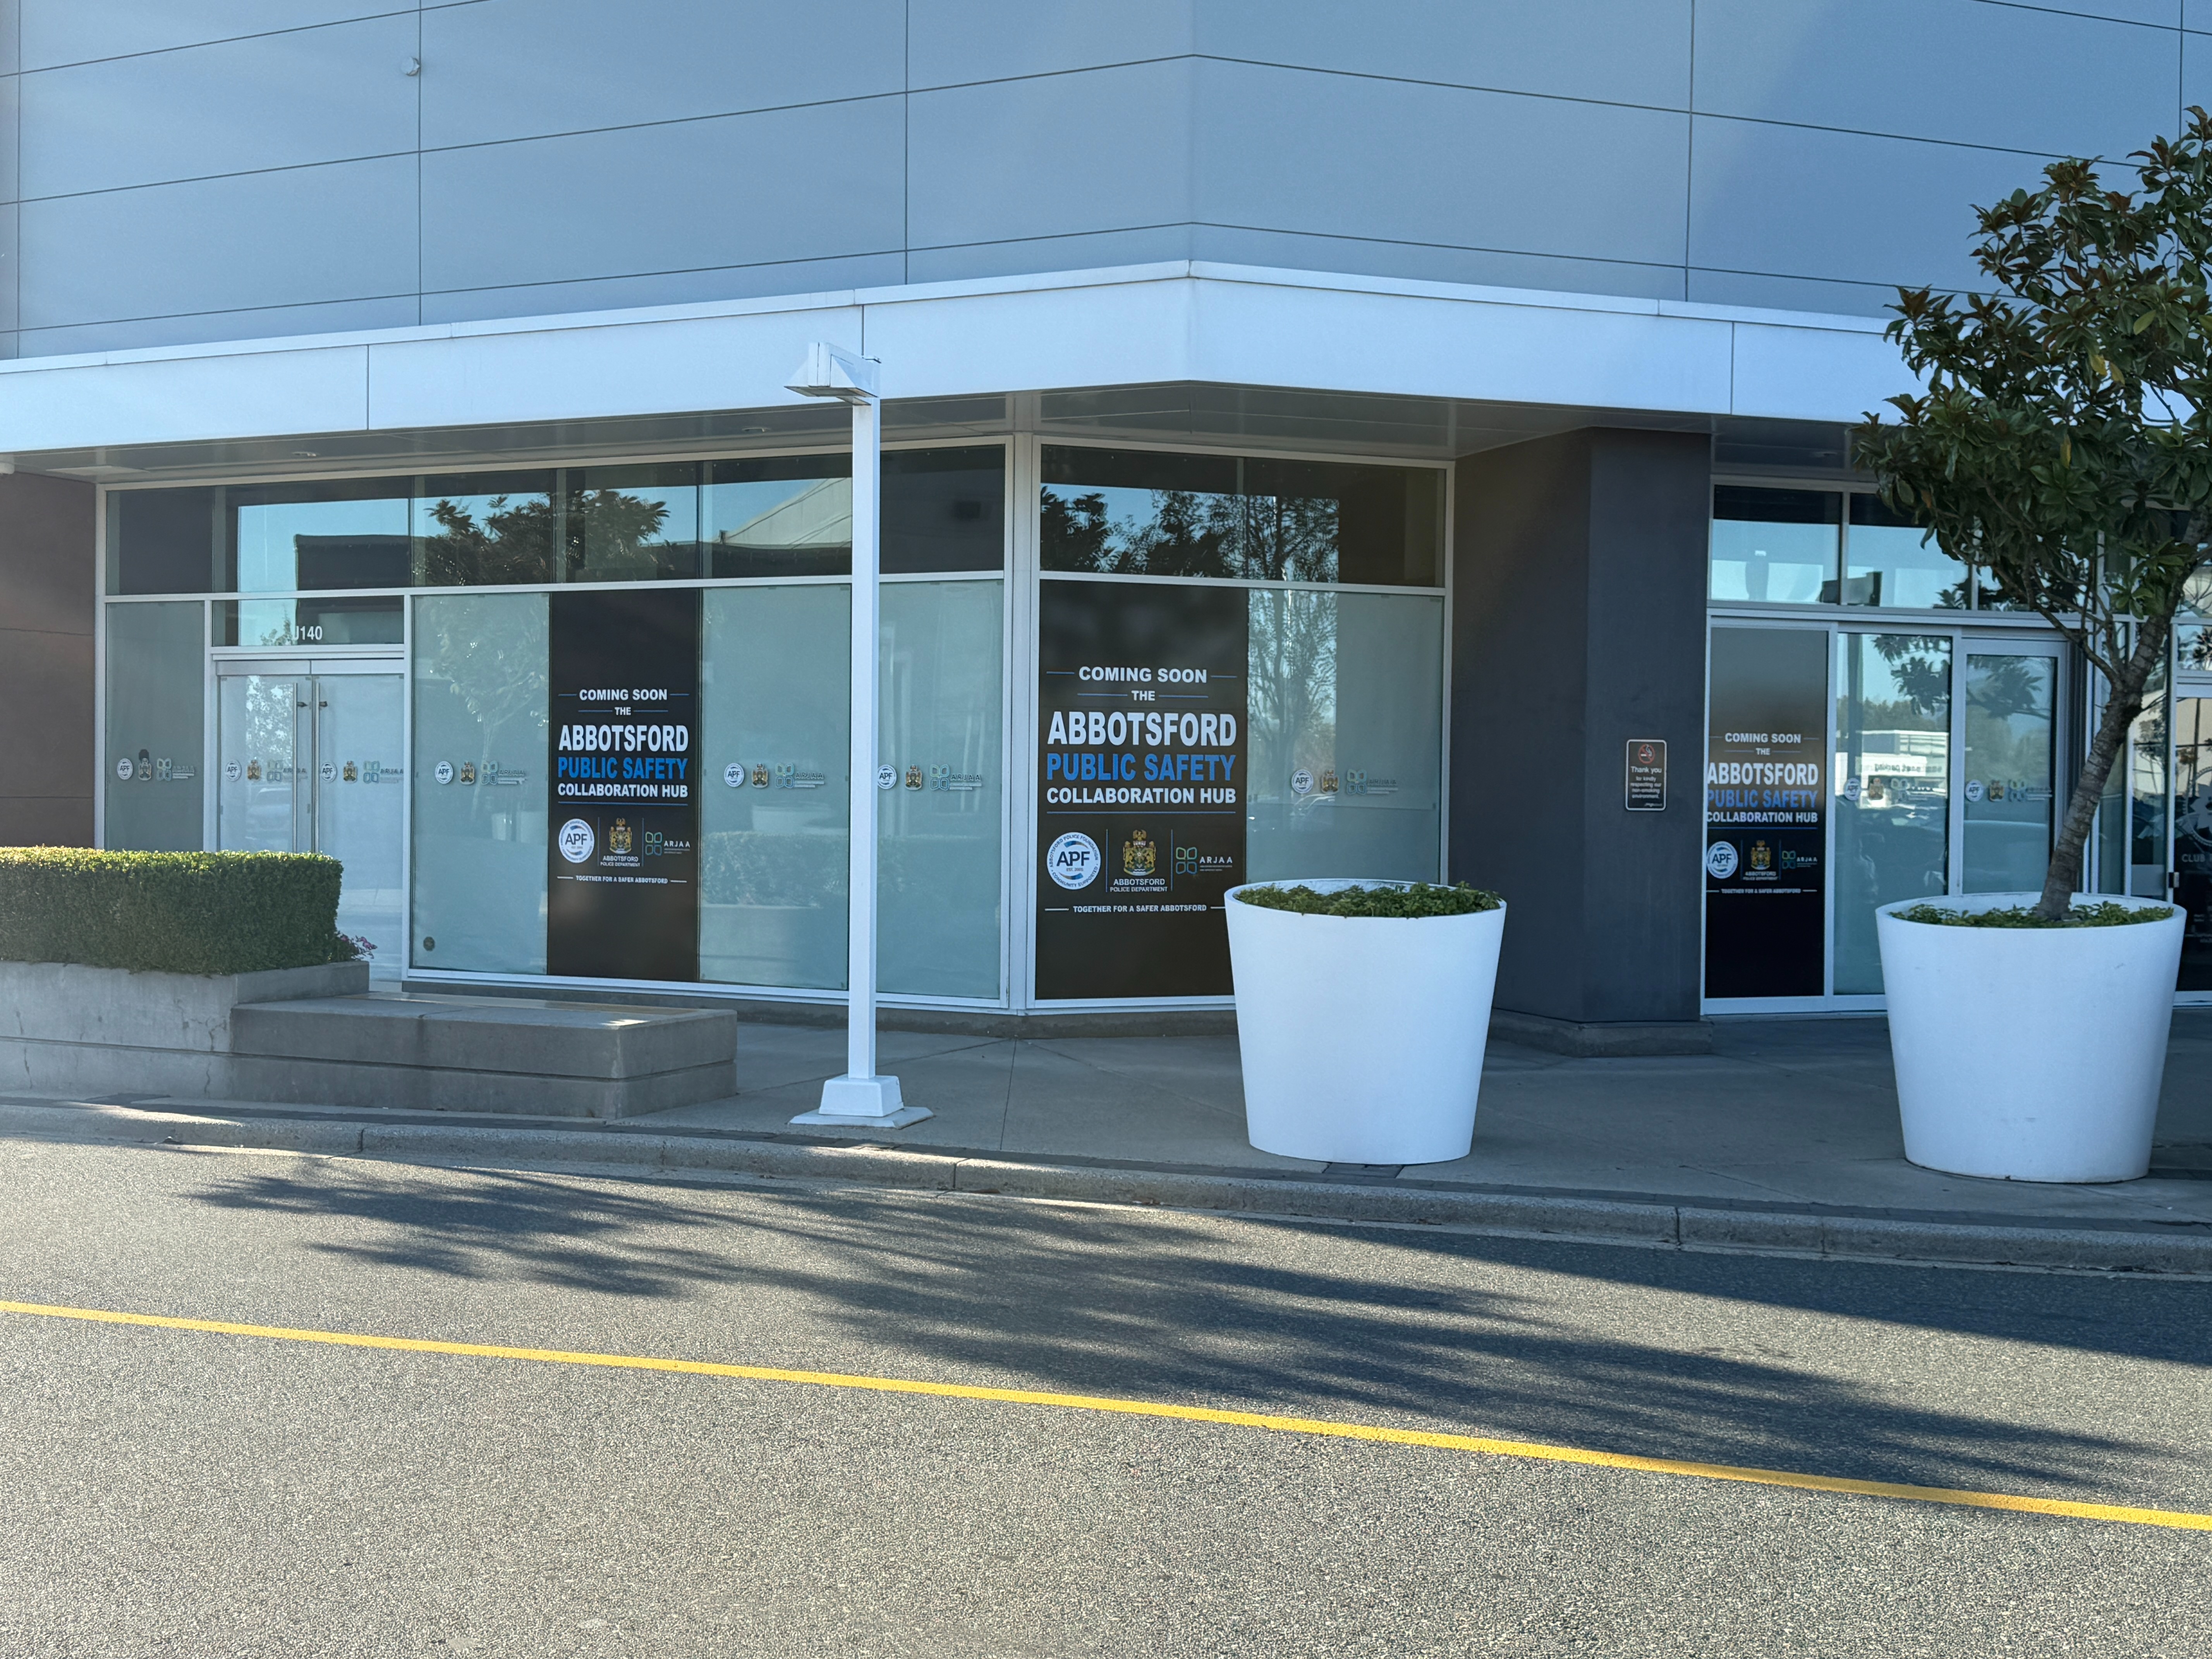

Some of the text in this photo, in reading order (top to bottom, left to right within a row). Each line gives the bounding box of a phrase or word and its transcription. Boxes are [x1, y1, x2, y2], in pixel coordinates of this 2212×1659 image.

[1079, 666, 1207, 683] COMING SOON
[579, 689, 667, 701] COMING SOON
[1131, 690, 1155, 701] THE
[614, 707, 631, 715] THE
[1047, 711, 1237, 746] ABBOTSFORD
[558, 725, 689, 752] ABBOTSFORD
[1725, 733, 1801, 743] COMING SOON
[558, 757, 687, 780] PUBLIC SAFETY
[1047, 753, 1235, 781] PUBLIC SAFETY
[1707, 762, 1819, 785] ABBOTSFORD
[558, 783, 688, 797] COLLABORATION HUB
[1047, 787, 1236, 804] COLLABORATION HUB
[1707, 790, 1818, 808] PUBLIC SAFETY
[1707, 811, 1818, 823] COLLABORATION HUB
[565, 833, 588, 845] APF
[1056, 851, 1091, 867] APF
[1712, 853, 1732, 864] APF
[2181, 853, 2205, 862] CLUB
